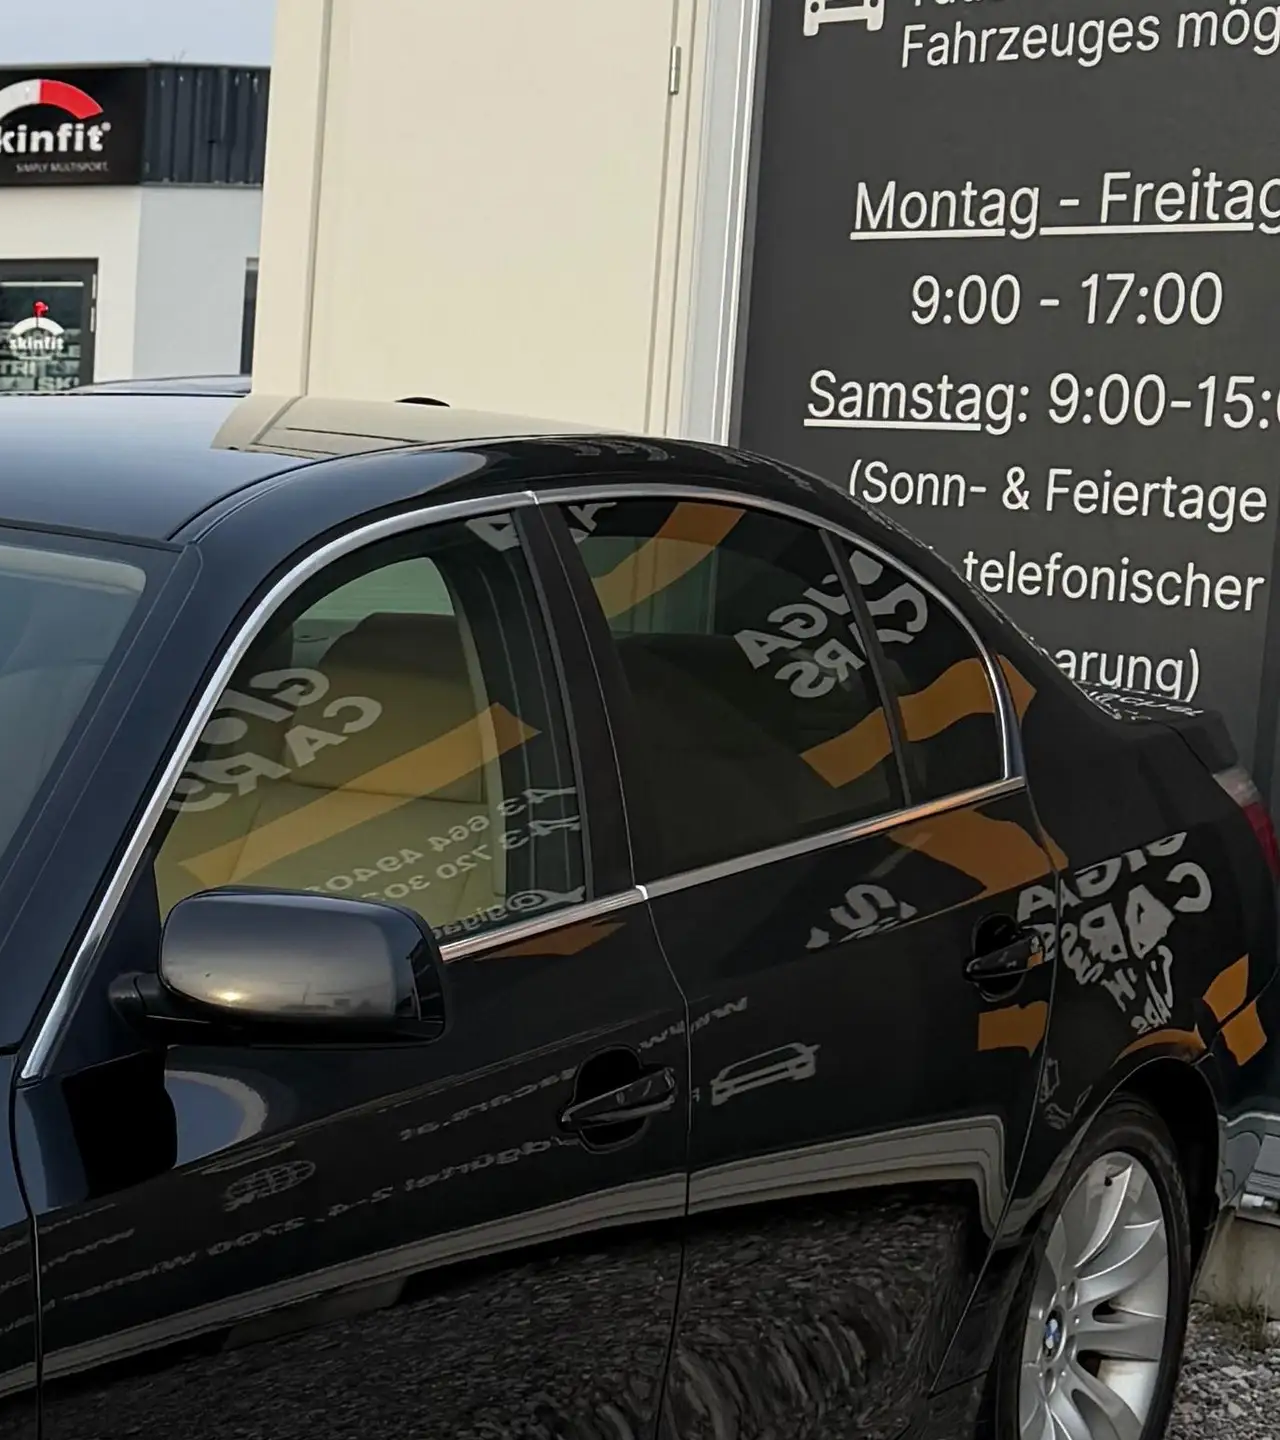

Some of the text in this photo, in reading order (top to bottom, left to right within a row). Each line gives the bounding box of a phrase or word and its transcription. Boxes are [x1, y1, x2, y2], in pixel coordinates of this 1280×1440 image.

[902, 14, 1161, 68] Fahrzeuges
[855, 181, 1040, 239] Montag
[1100, 168, 1280, 235] Freitag
[911, 274, 1022, 326] 9:00
[1081, 272, 1224, 326] 17:00
[808, 369, 1280, 436] Samstag: 9:00-15:
[848, 459, 1268, 533] (Sonn- & Feiertage
[962, 550, 1265, 612] telefonischer
